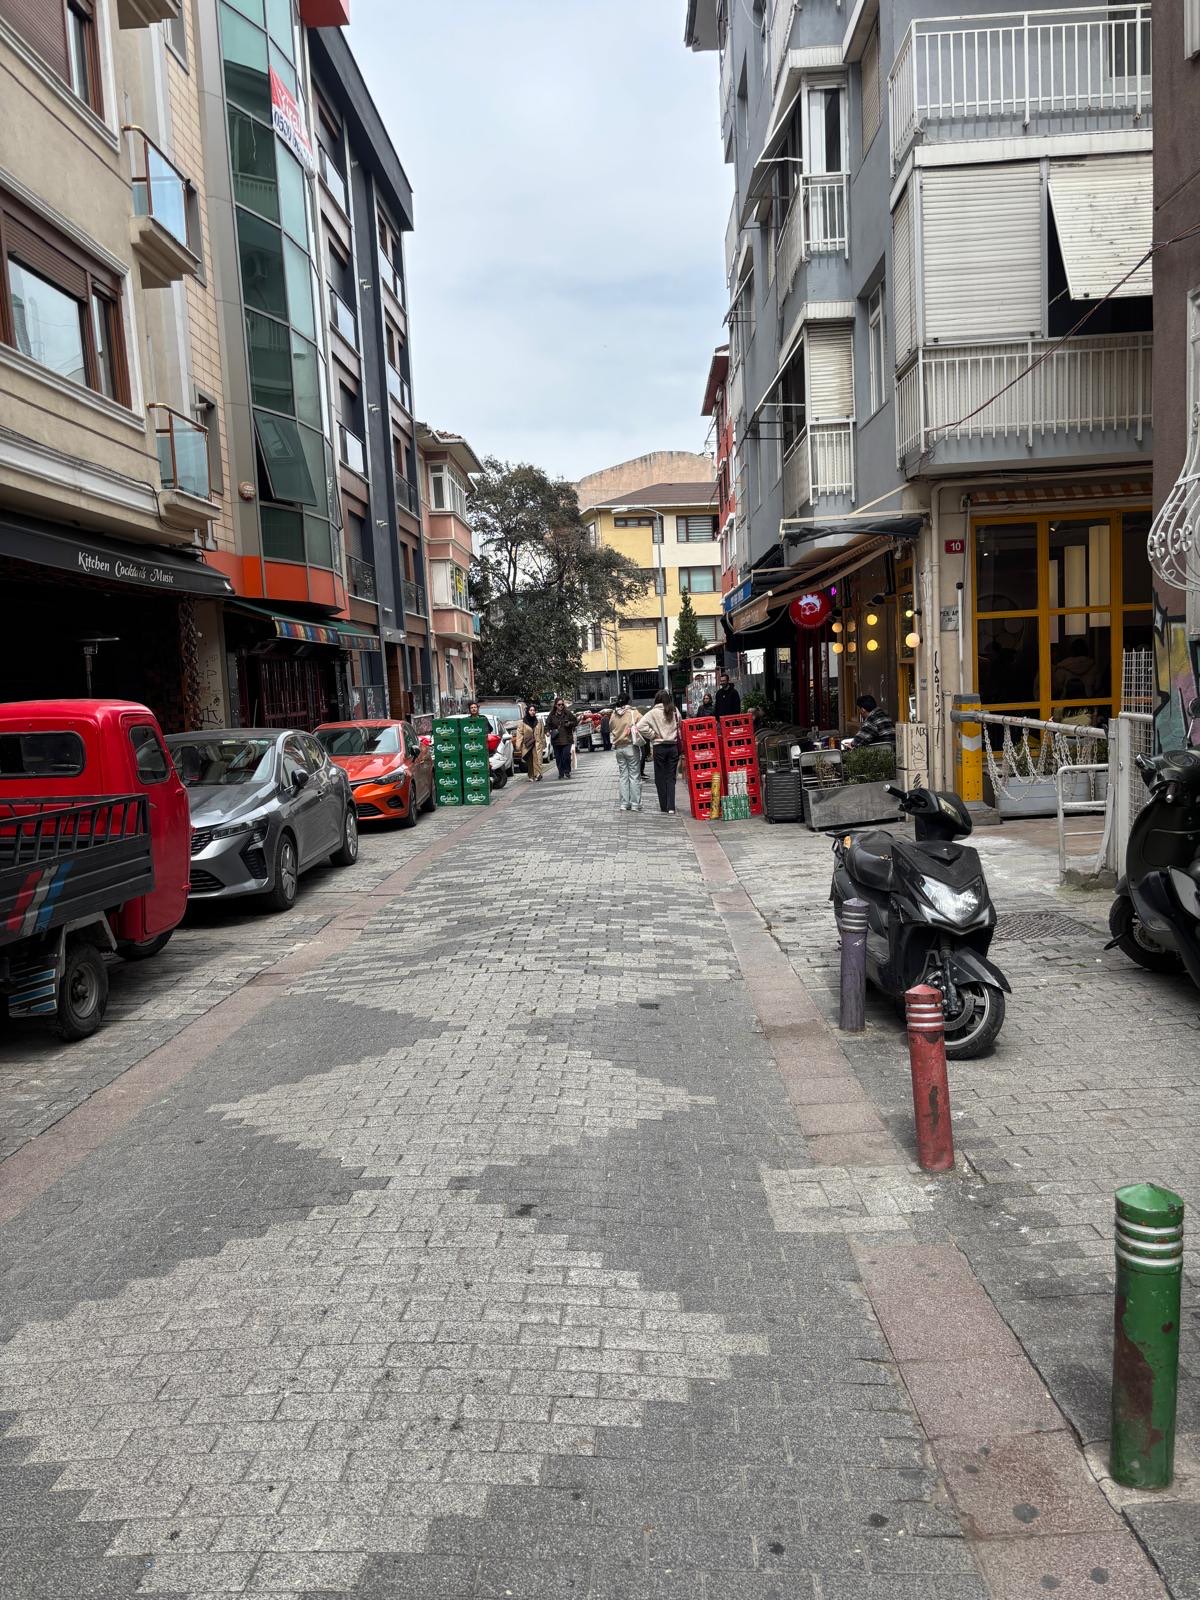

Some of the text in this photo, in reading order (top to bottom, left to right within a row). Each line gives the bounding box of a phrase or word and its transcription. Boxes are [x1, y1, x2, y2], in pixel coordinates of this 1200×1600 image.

[950, 541, 962, 552] 10
[78, 551, 110, 572] Kitchen
[149, 568, 174, 583] Music
